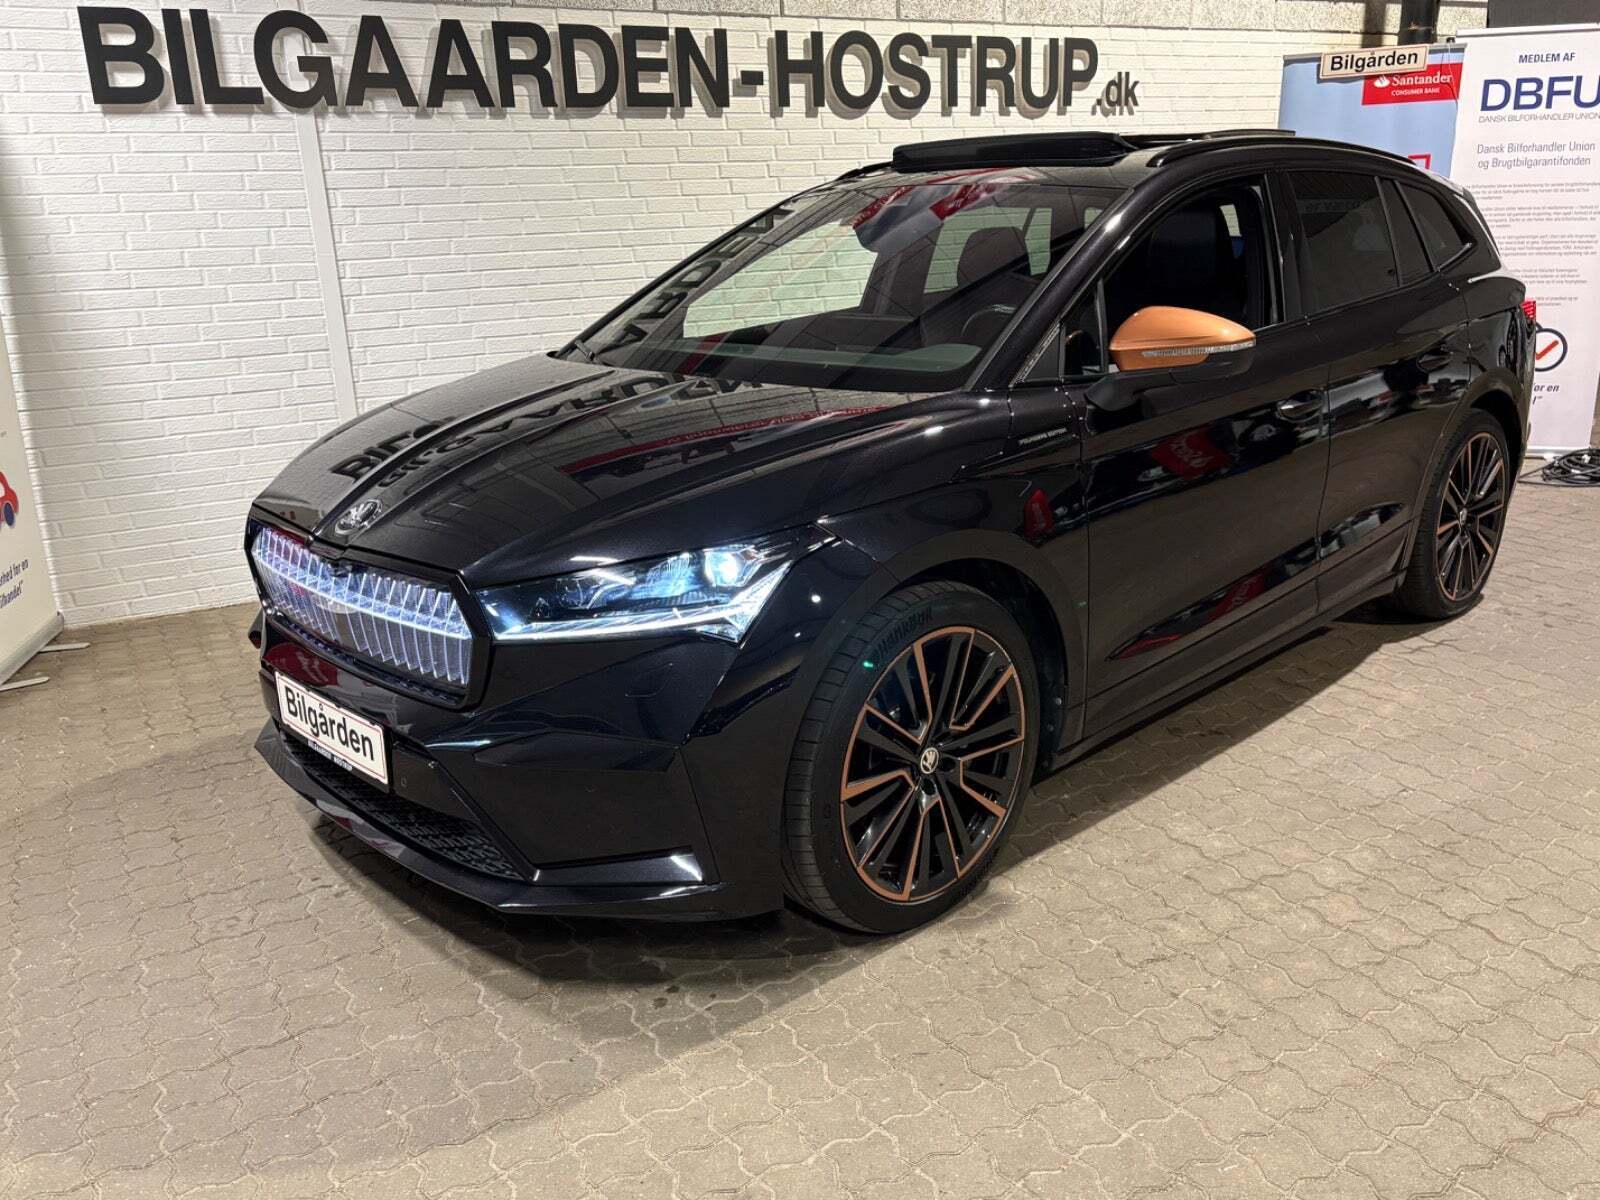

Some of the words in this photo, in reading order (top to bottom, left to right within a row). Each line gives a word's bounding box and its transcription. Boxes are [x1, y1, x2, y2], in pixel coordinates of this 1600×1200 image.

[1330, 51, 1418, 73] Bilgården
[1519, 53, 1560, 64] MEDLEM
[1563, 52, 1576, 62] AF
[1391, 72, 1453, 86] Santander
[1391, 88, 1424, 97] CONSUMER
[1424, 87, 1440, 95] BANK
[1480, 75, 1600, 111] DBFU
[1478, 114, 1507, 123] DANSK
[1507, 112, 1574, 122] BILFORHANDLER
[1477, 143, 1505, 154] Dansk
[1507, 141, 1566, 153] Bilforhandler
[1569, 141, 1596, 152] Union
[1477, 159, 1489, 170] og
[1491, 156, 1591, 169] Brugtbilgarantifonden
[1534, 382, 1545, 392] or
[1547, 384, 1559, 392] en
[284, 686, 374, 762] Bilgården
